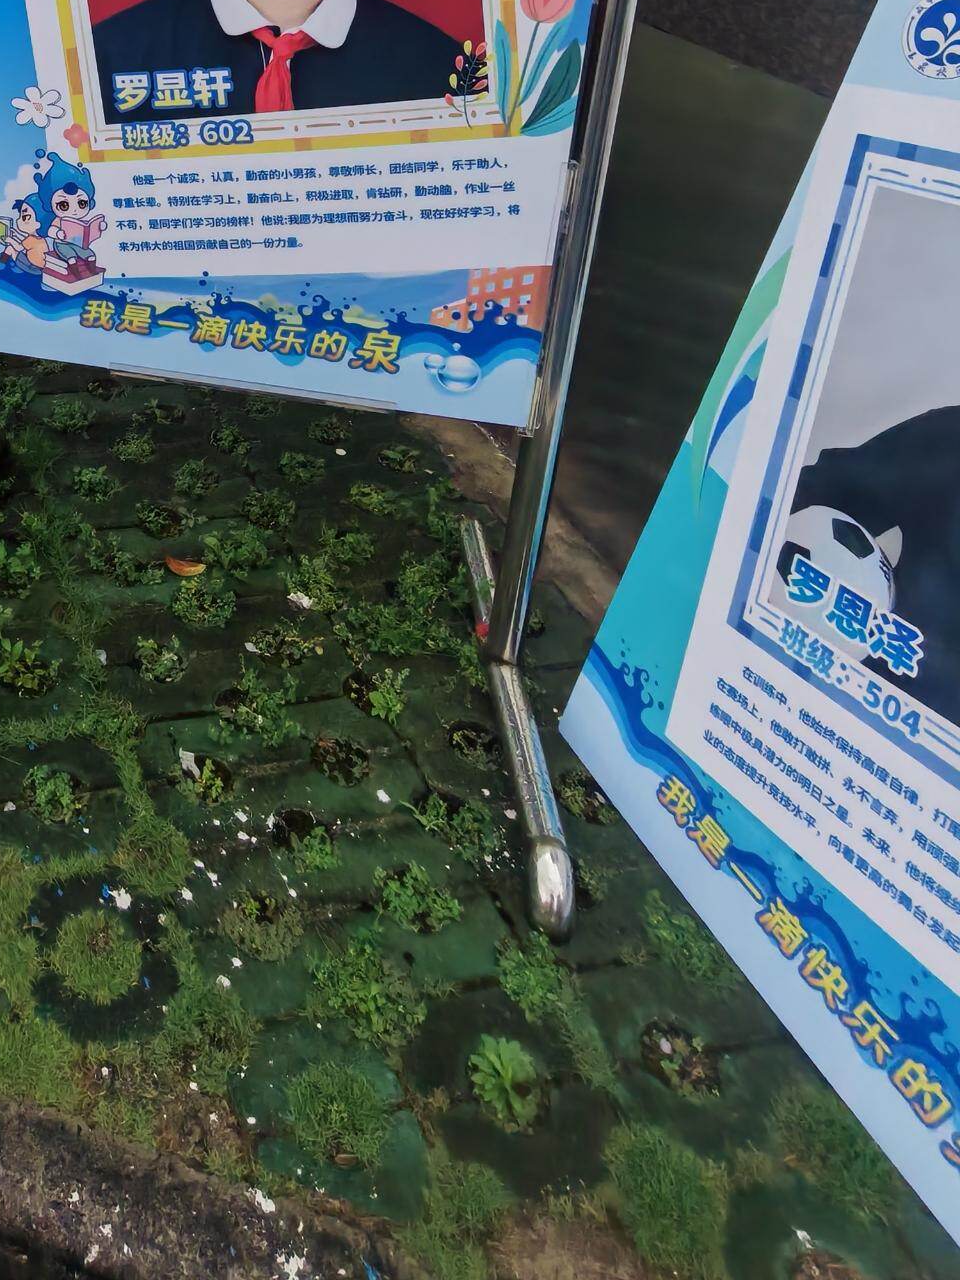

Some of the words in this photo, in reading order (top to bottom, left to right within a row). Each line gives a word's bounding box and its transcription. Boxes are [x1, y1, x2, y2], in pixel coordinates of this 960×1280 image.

[113, 68, 233, 113] 罗显轩
[80, 298, 402, 375] 我是一滴快乐的泉
[786, 556, 922, 674] 罗恩泽
[656, 775, 960, 1175] 我是一滴快乐的
